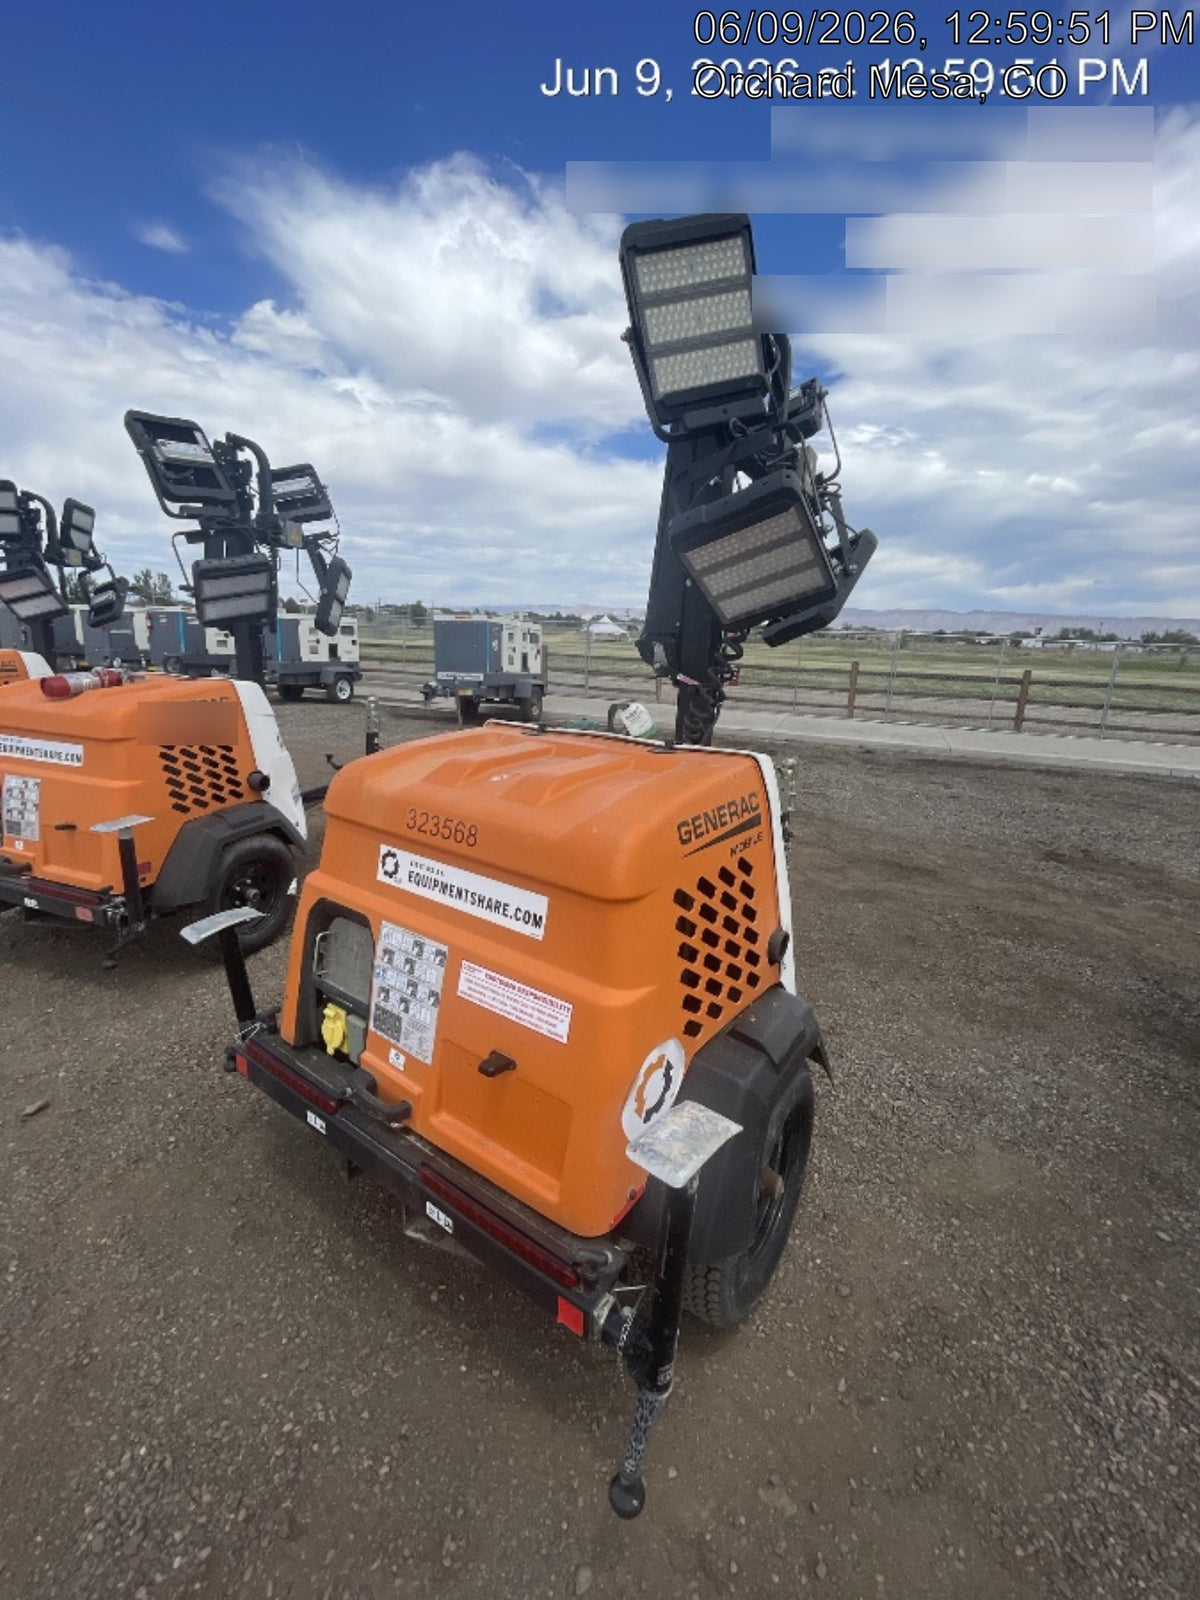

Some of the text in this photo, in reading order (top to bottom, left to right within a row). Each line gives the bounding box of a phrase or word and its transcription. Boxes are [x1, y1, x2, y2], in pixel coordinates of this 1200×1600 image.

[406, 808, 477, 847] 323568
[677, 791, 760, 845] GENERAC
[408, 869, 544, 930] EQUIPMENTSHARE.COM
